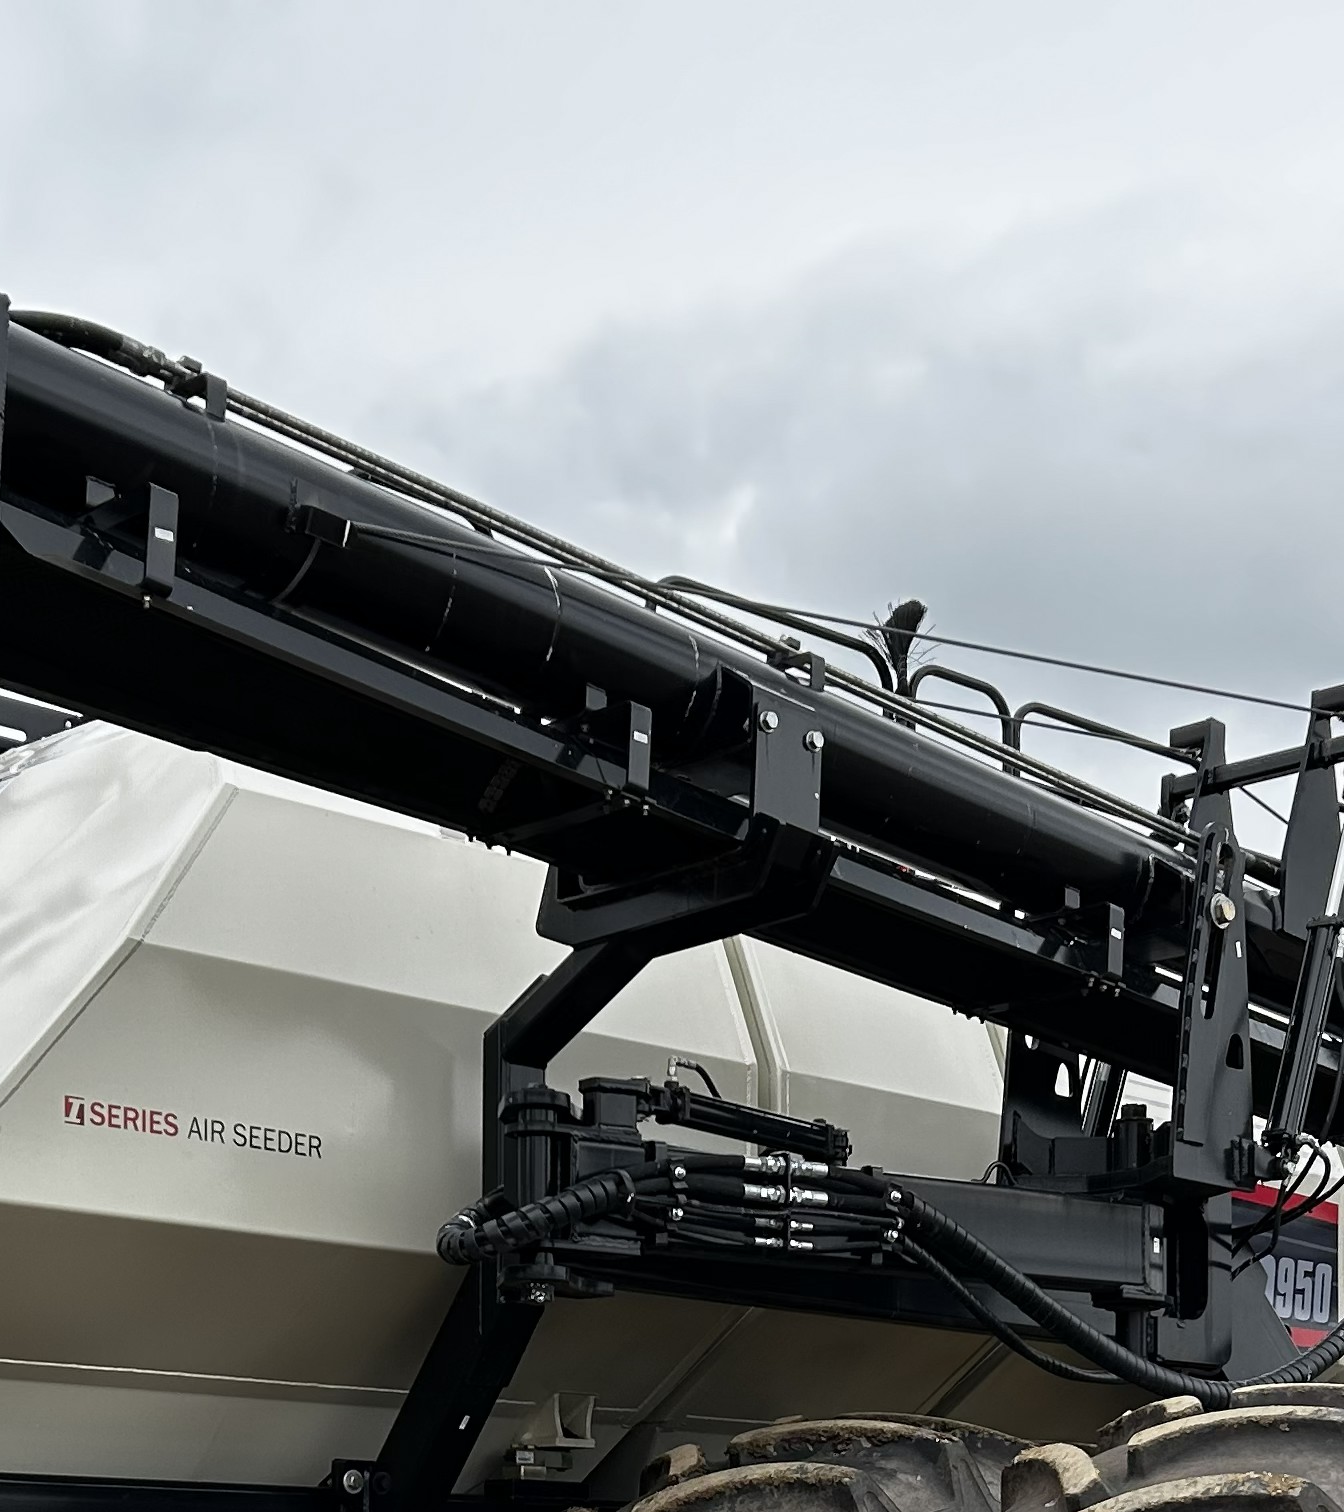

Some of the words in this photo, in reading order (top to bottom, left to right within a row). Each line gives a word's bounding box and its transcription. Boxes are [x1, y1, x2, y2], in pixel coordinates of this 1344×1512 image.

[89, 1101, 179, 1137] SERIES
[187, 1116, 226, 1145] AIR
[232, 1123, 323, 1159] SEEDER
